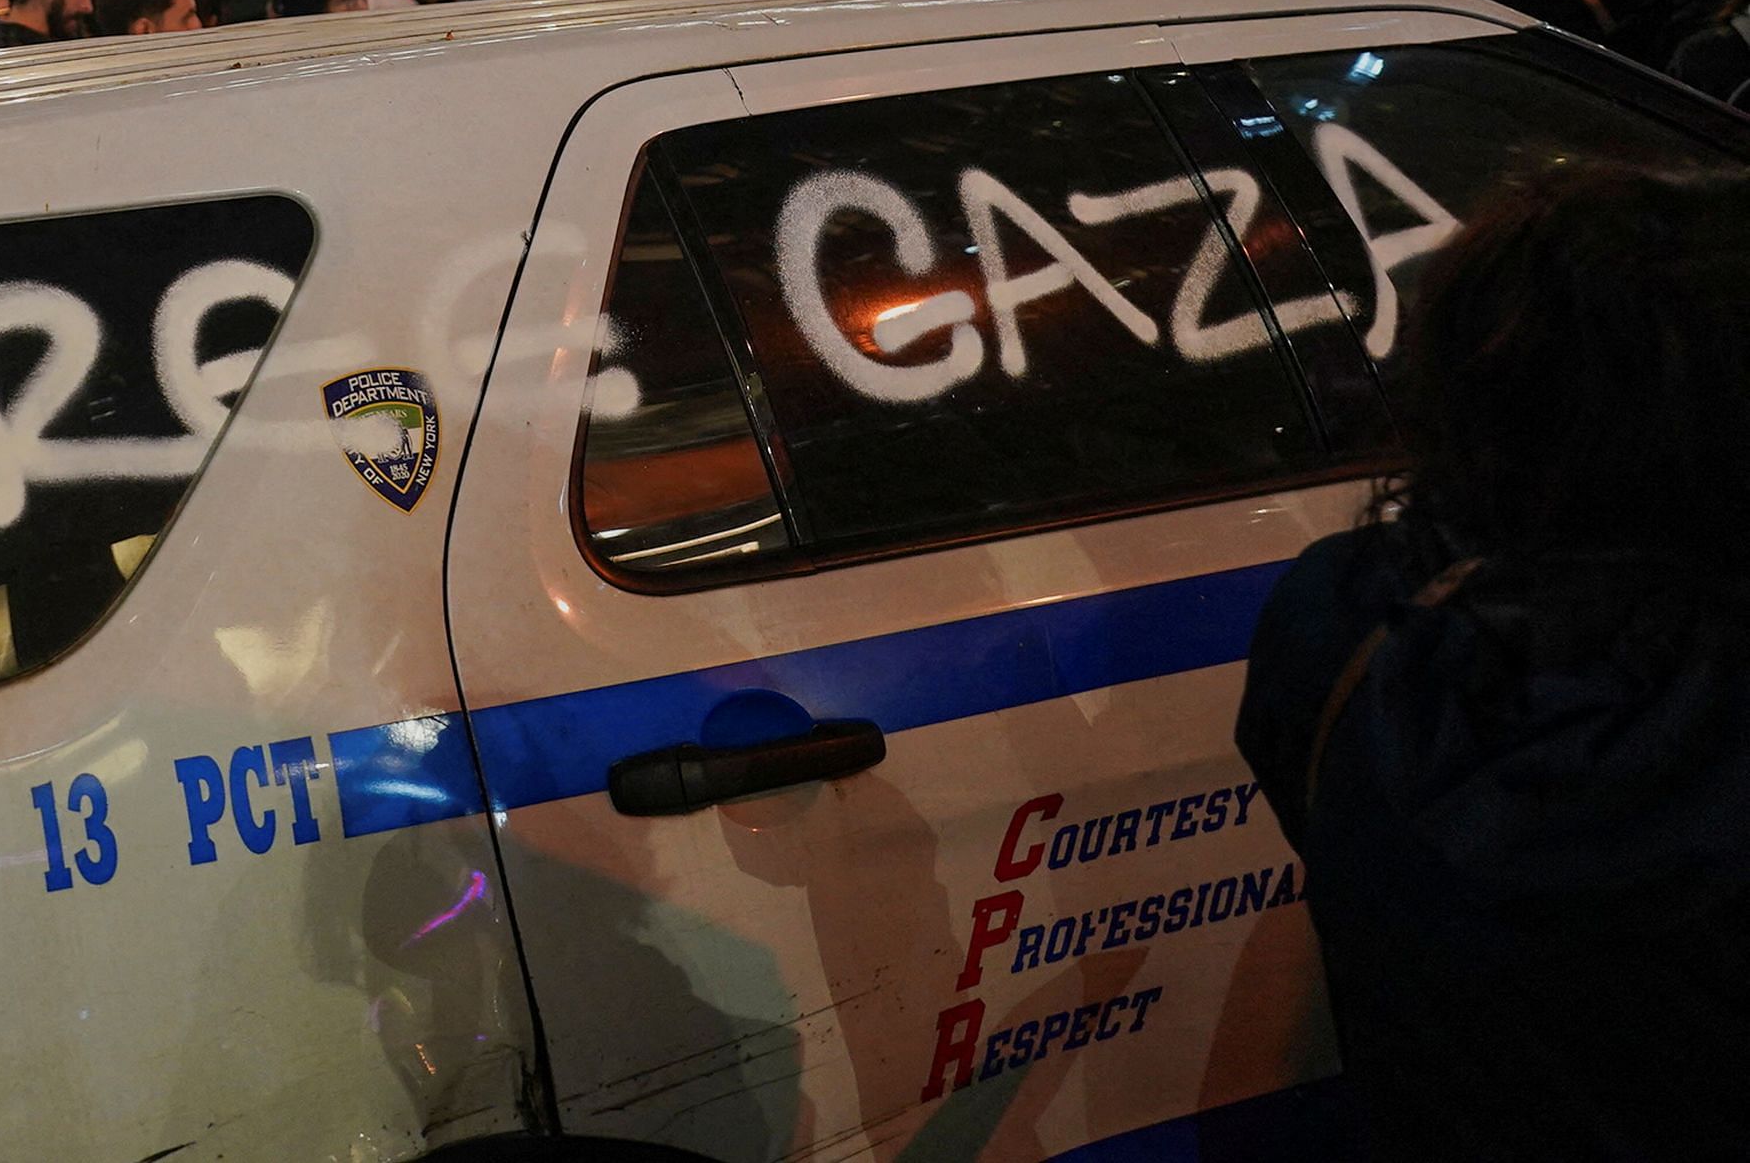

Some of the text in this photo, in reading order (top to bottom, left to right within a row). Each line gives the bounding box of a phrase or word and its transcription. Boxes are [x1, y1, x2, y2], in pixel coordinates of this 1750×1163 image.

[772, 120, 1464, 403] GAZA
[332, 386, 428, 417] DEPARTMENT
[348, 372, 403, 392] POLICE
[363, 467, 384, 486] OF
[415, 415, 437, 486] NEW YORK
[31, 772, 118, 892] 13
[174, 736, 321, 865] PCT
[955, 863, 1307, 992] PROFESSIONA
[921, 986, 1163, 1104] RESPECT
